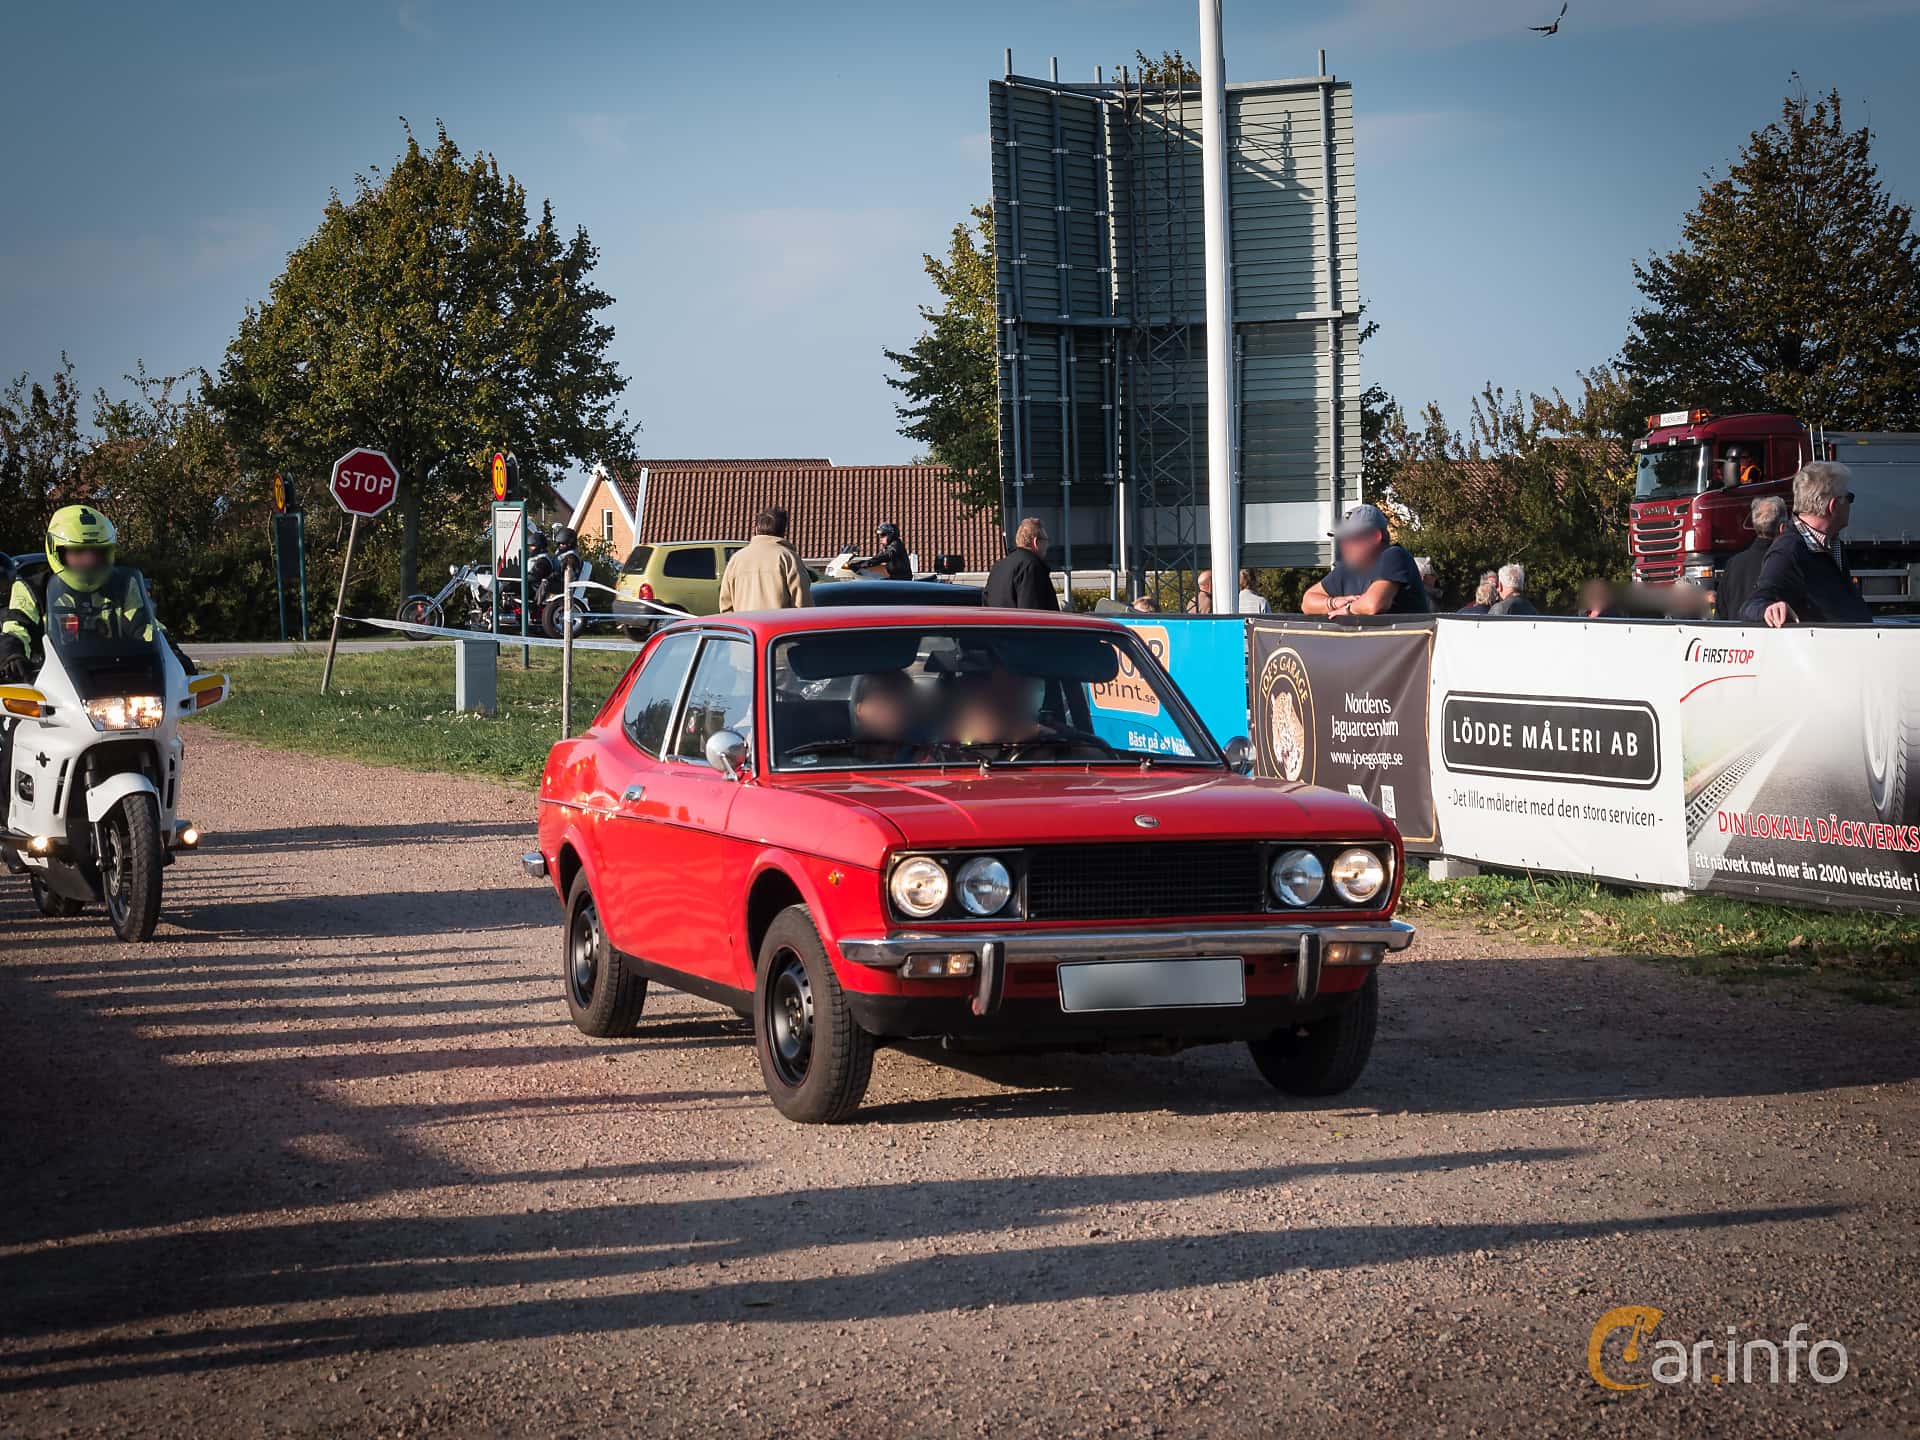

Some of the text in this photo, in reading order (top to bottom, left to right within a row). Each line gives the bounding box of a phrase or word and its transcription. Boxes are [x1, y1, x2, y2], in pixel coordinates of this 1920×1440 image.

[339, 470, 392, 495] STOP
[1280, 655, 1309, 704] GARAGE
[1344, 691, 1392, 714] Nordens
[1128, 731, 1147, 748] Bäst
[1148, 732, 1159, 750] på
[1452, 717, 1638, 757] LÖDDE MÅLERI AB
[1453, 788, 1467, 807] Det
[1468, 790, 1485, 809] lilla
[1486, 792, 1528, 814] måleriet
[1530, 798, 1554, 816] med
[1557, 798, 1580, 819] den
[1583, 803, 1606, 821] stora
[1609, 806, 1655, 827] servicen
[1717, 810, 1920, 853] DIN LOKALA DÄCKVERKS
[1695, 851, 1710, 869] Ett
[1711, 854, 1751, 874] nätverk
[1751, 857, 1776, 877] med
[1776, 863, 1800, 879] mer
[1801, 861, 1818, 881] än
[1818, 863, 1848, 884] 2000
[1848, 867, 1913, 891] verkstäder
